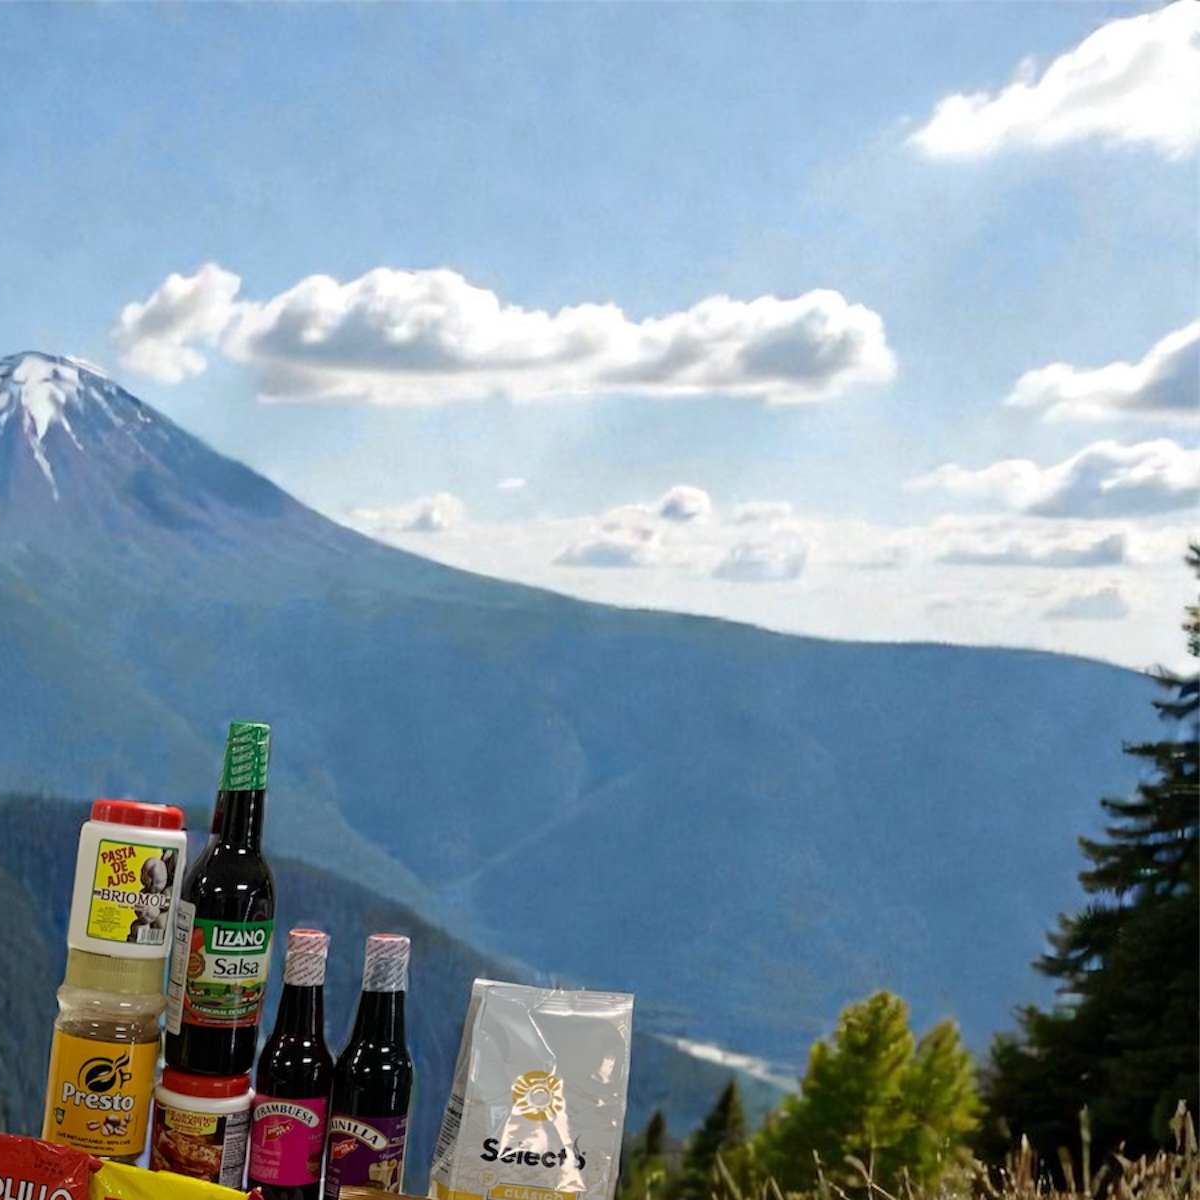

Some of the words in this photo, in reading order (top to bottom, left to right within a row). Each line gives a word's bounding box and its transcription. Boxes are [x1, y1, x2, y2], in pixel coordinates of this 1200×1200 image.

[101, 846, 136, 864] PASTA
[110, 860, 128, 874] DE
[107, 870, 136, 888] AJOS
[211, 926, 266, 951] LIZANO
[213, 958, 259, 976] Salsa
[199, 1005, 227, 1015] ORIGINAL
[62, 1081, 135, 1112] Presto
[255, 1102, 314, 1126] FRAMBUESA
